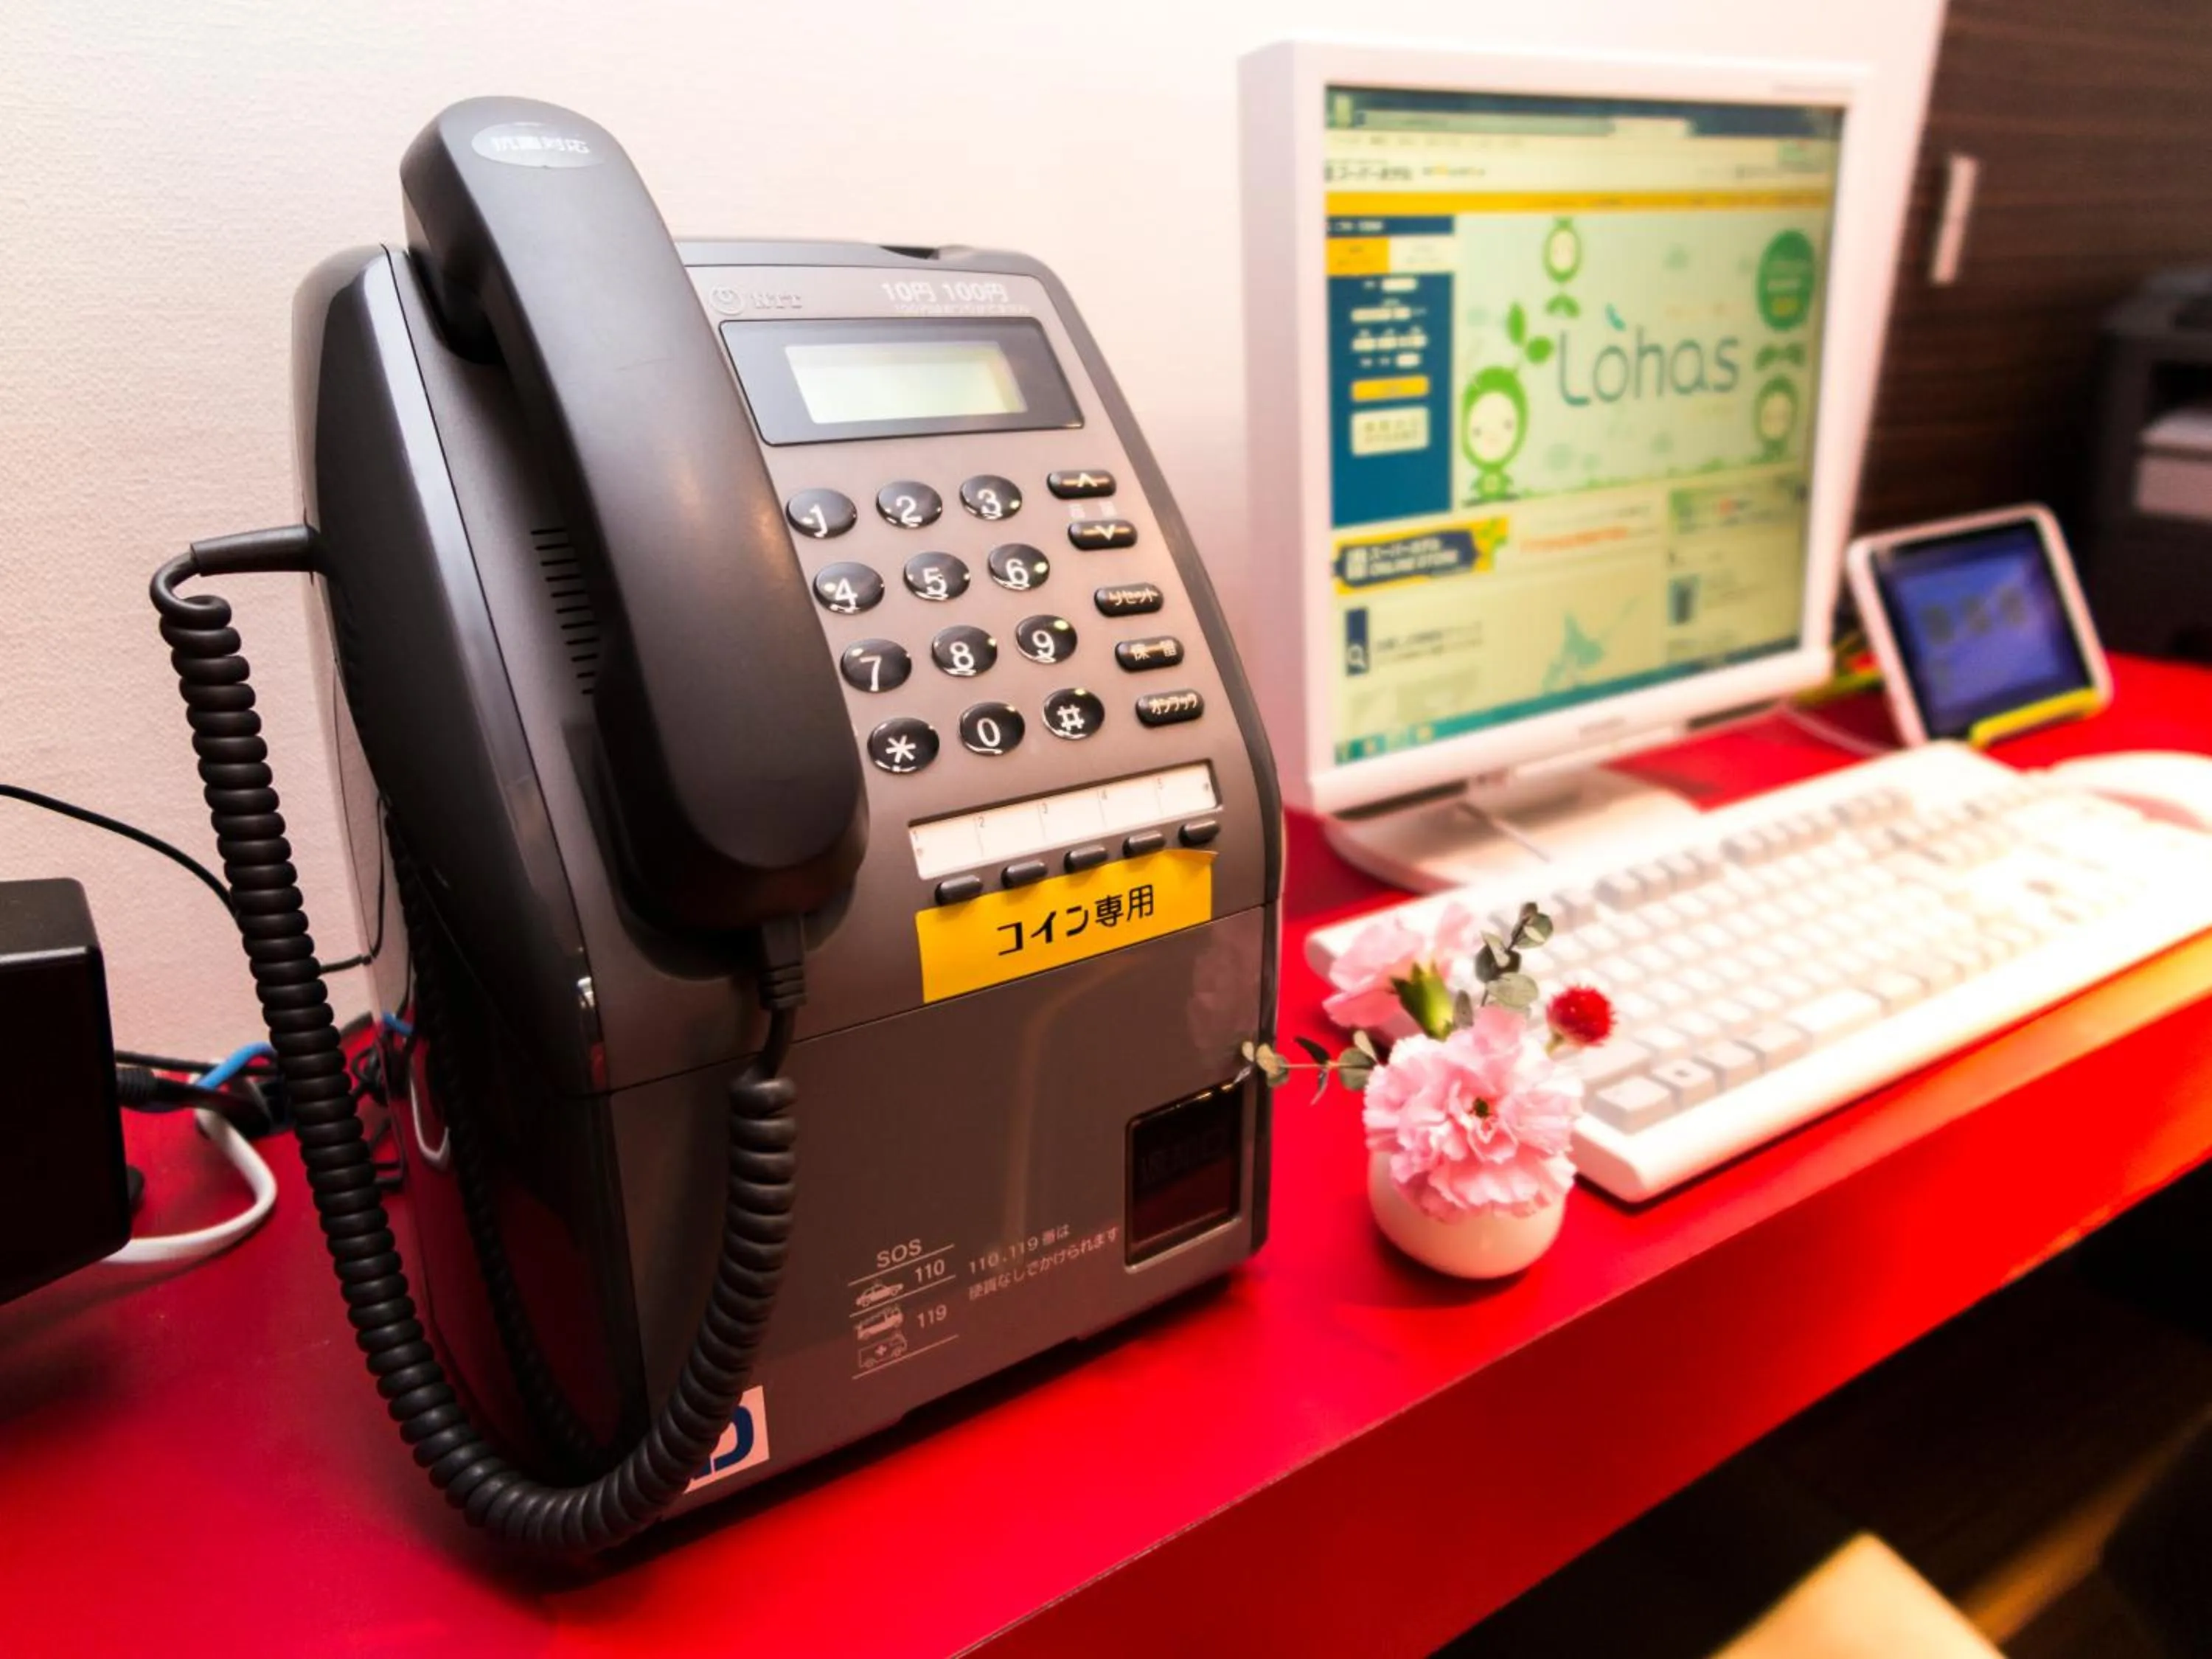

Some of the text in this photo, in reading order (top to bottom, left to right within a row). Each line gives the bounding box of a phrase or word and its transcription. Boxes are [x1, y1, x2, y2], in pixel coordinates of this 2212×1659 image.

[880, 281, 1009, 303] 10円 100円
[896, 495, 922, 524] 2
[978, 489, 1002, 518] 3
[810, 504, 828, 538] 1
[923, 567, 947, 596] 5
[1006, 558, 1029, 586] 6
[835, 578, 858, 611] 4
[1108, 588, 1158, 605] リセット
[950, 641, 974, 672] 8
[1032, 630, 1054, 658] 9
[860, 655, 882, 692] 7
[977, 717, 1001, 747] 0
[997, 884, 1154, 956] コイン専用
[877, 1239, 923, 1269] SOS
[914, 1259, 946, 1284] 110
[917, 1304, 947, 1329] 119
